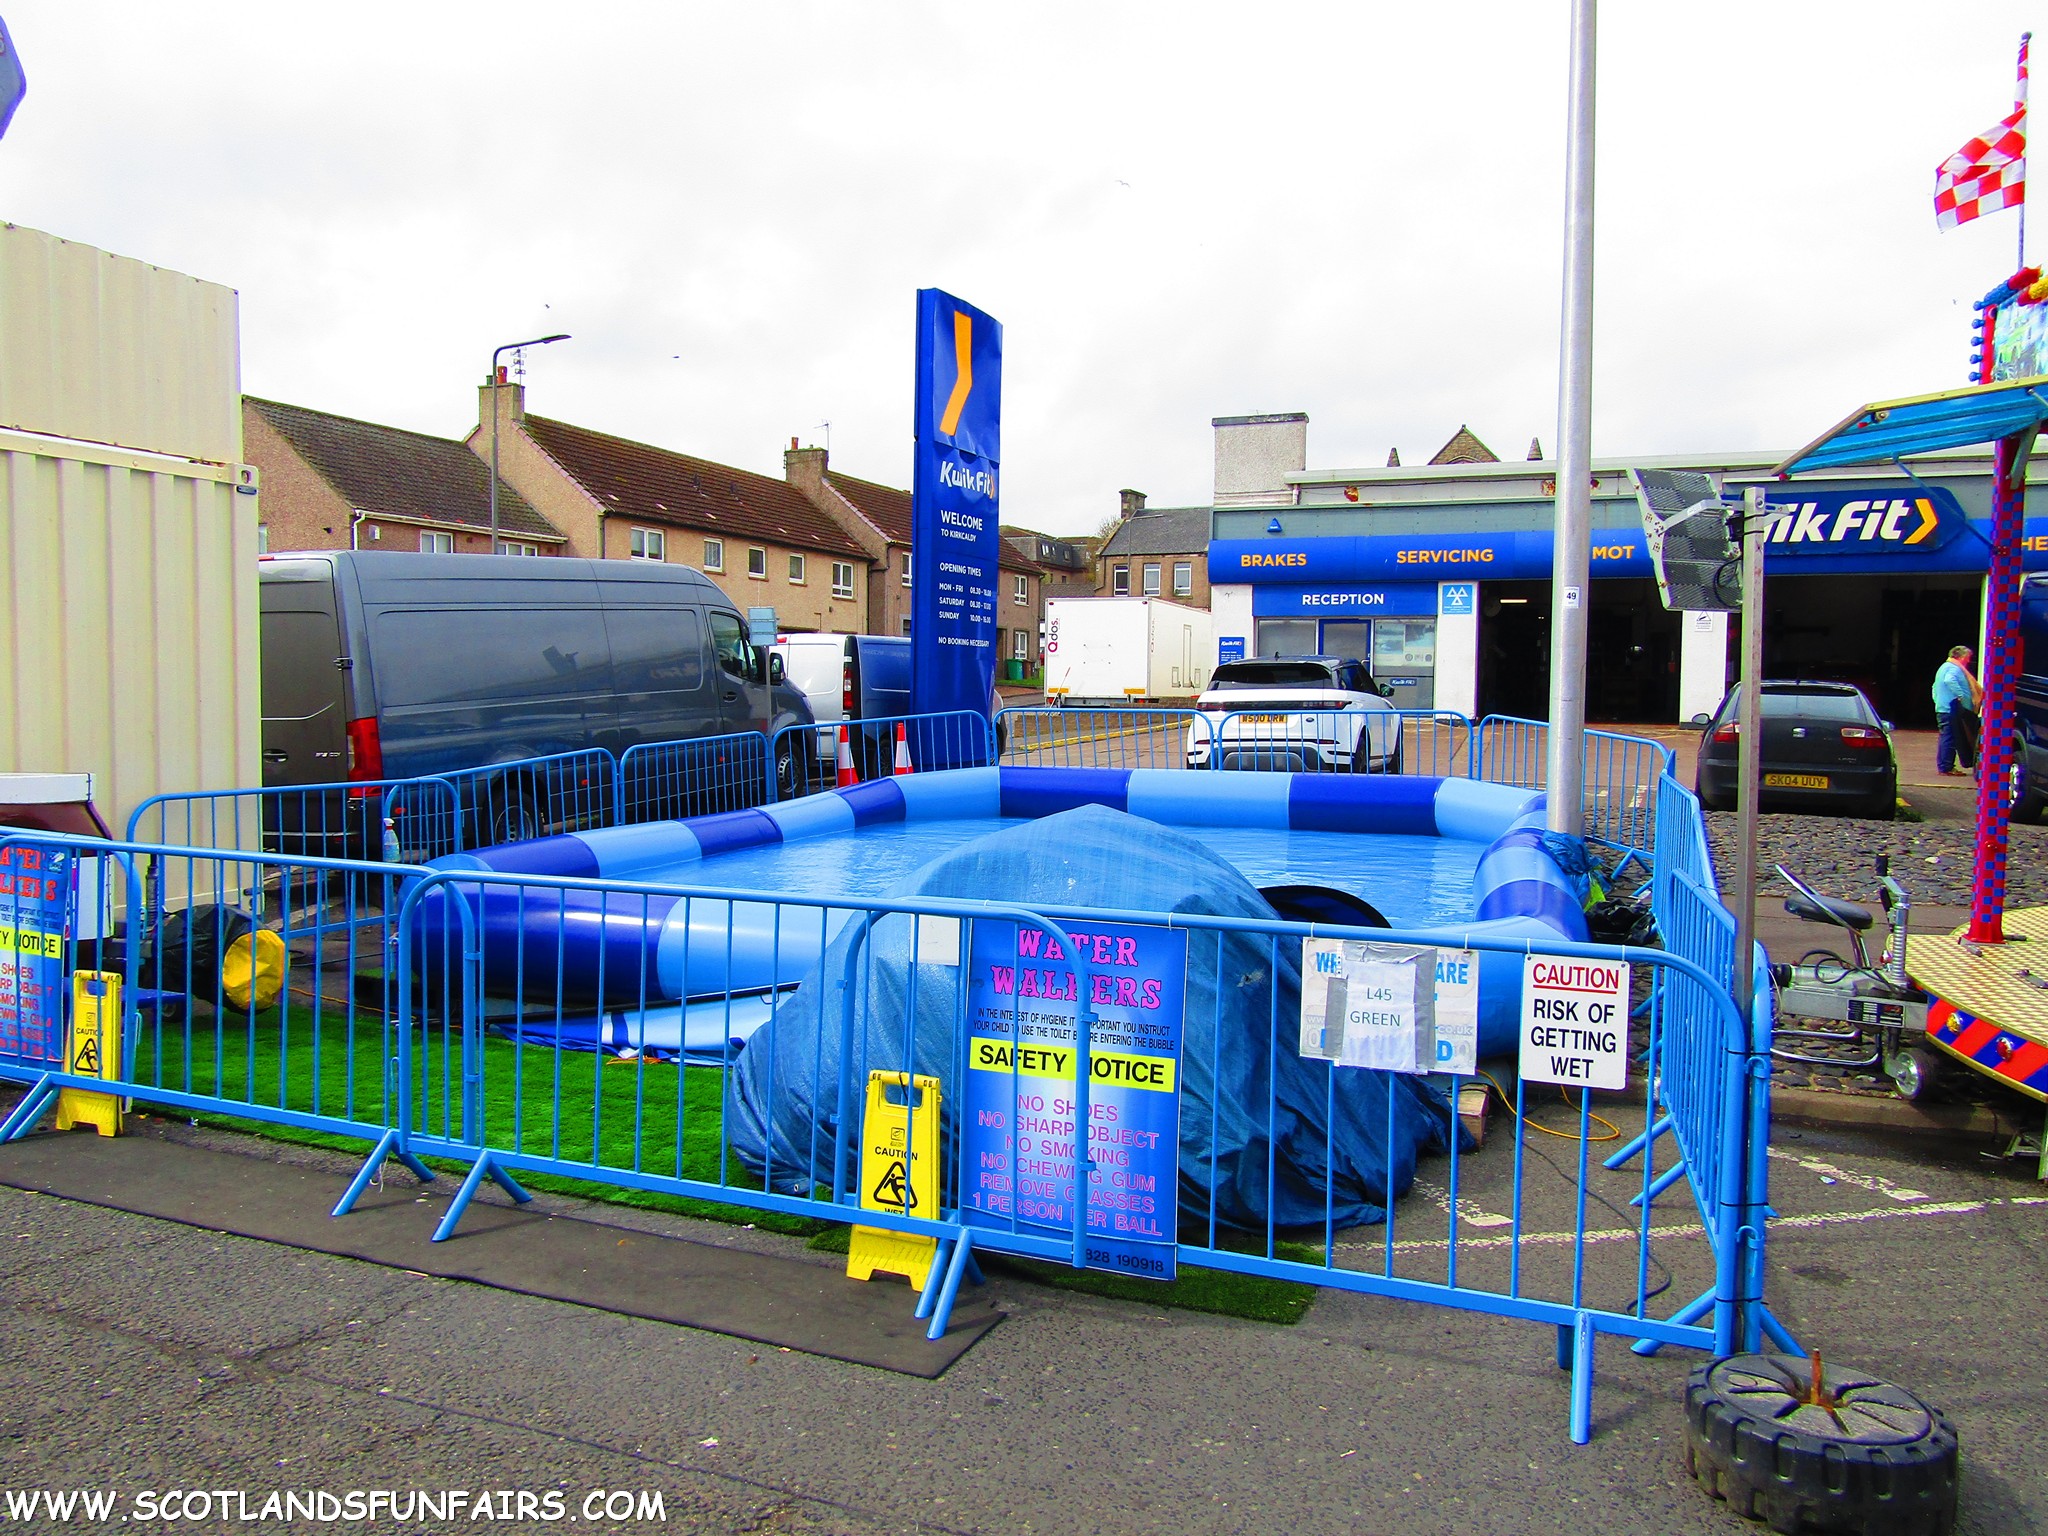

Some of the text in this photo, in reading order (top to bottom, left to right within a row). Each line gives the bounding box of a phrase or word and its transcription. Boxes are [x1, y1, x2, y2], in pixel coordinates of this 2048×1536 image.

[941, 510, 983, 531] WELCOME
[941, 528, 977, 542] TO KIRKCALDY
[1240, 553, 1307, 568] BRAKES
[1396, 548, 1494, 565] SERVICING
[1592, 544, 1635, 560] MOT
[940, 562, 982, 577] OPENING TIMES
[939, 582, 952, 591] MON
[955, 584, 964, 593] FRI
[1566, 592, 1577, 600] 49
[939, 597, 965, 606] SATURDAY
[1302, 593, 1384, 606] RECEPTION
[939, 610, 960, 620] SUNDAY
[938, 636, 947, 644] NO
[948, 637, 970, 646] BOOKING
[1770, 775, 1822, 787] SK04 UUY
[2, 962, 34, 979] SHES
[1532, 962, 1620, 990] CAUTION
[1367, 987, 1392, 1002] L45
[1350, 1010, 1401, 1027] GREEN
[1533, 998, 1616, 1024] RISK OF
[978, 1007, 985, 1017] IN
[986, 1008, 998, 1019] THE
[1000, 1010, 1030, 1022] INTEEST
[1031, 1012, 1039, 1023] OF
[1041, 1013, 1067, 1026] HYGIENE
[1068, 1016, 1075, 1027] IT
[1123, 1022, 1136, 1033] YOU
[1138, 1023, 1170, 1036] INSTRUCT
[973, 1020, 989, 1031] YOUR
[991, 1022, 1009, 1034] CHILD
[1021, 1025, 1034, 1036] USE
[1036, 1026, 1048, 1038] THE
[1050, 1027, 1071, 1040] TOILET
[1100, 1033, 1131, 1047] ENTERING
[1134, 1036, 1147, 1048] THE
[1148, 1037, 1174, 1051] BUBBLE
[1530, 1026, 1617, 1054] GETTING
[979, 1044, 1165, 1085] SAFETY OTICE
[1551, 1056, 1594, 1080] WET
[1018, 1094, 1044, 1112] NO
[978, 1110, 1005, 1129] NO
[1016, 1115, 1075, 1137] SHARP
[1006, 1135, 1032, 1153] NO
[981, 1152, 1155, 1192] NO CHEWIG GUM
[981, 1173, 1155, 1214] REMOVE GASSES
[973, 1192, 981, 1208] 1
[1071, 1209, 1107, 1228] ER
[1115, 1214, 1163, 1237] BALL
[1116, 1254, 1164, 1273] 190918
